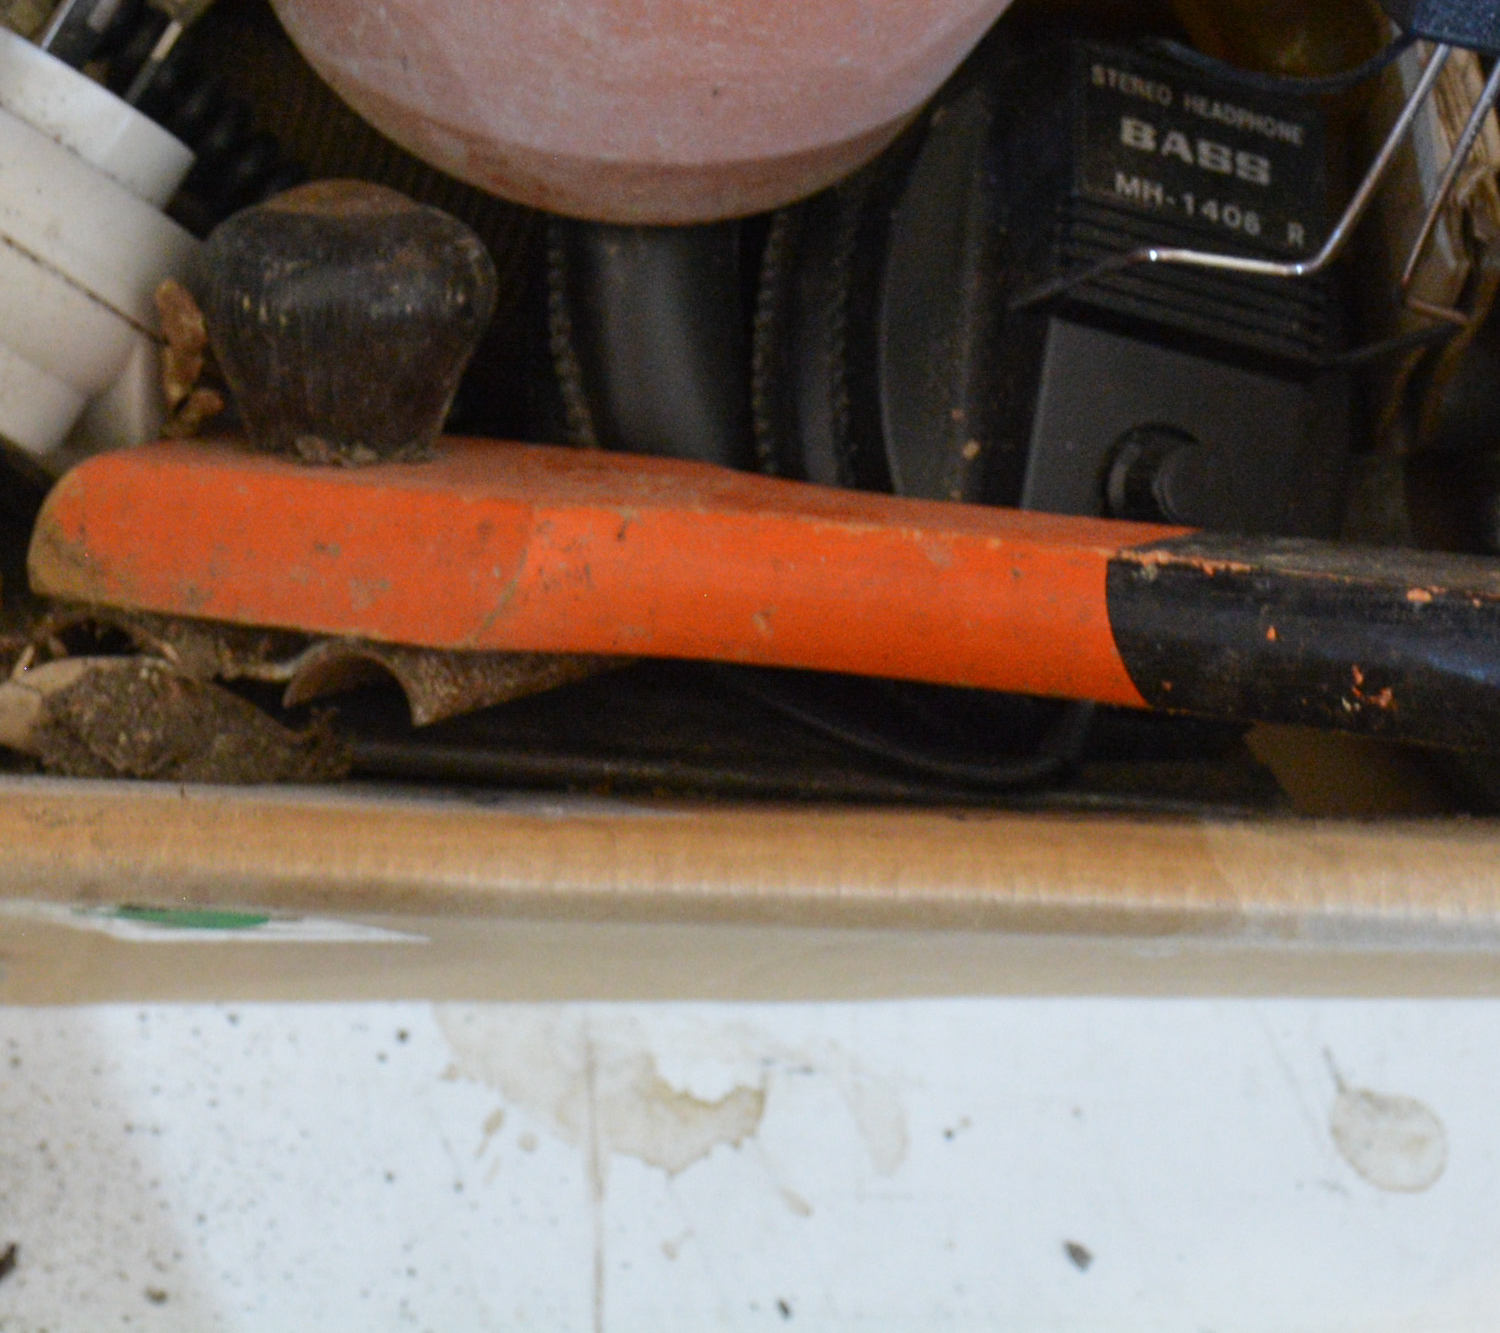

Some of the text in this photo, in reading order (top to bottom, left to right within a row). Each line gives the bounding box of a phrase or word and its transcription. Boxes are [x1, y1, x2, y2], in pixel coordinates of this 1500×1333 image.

[1091, 63, 1304, 146] STEREO HEADPHONE
[1120, 115, 1271, 187] BASS
